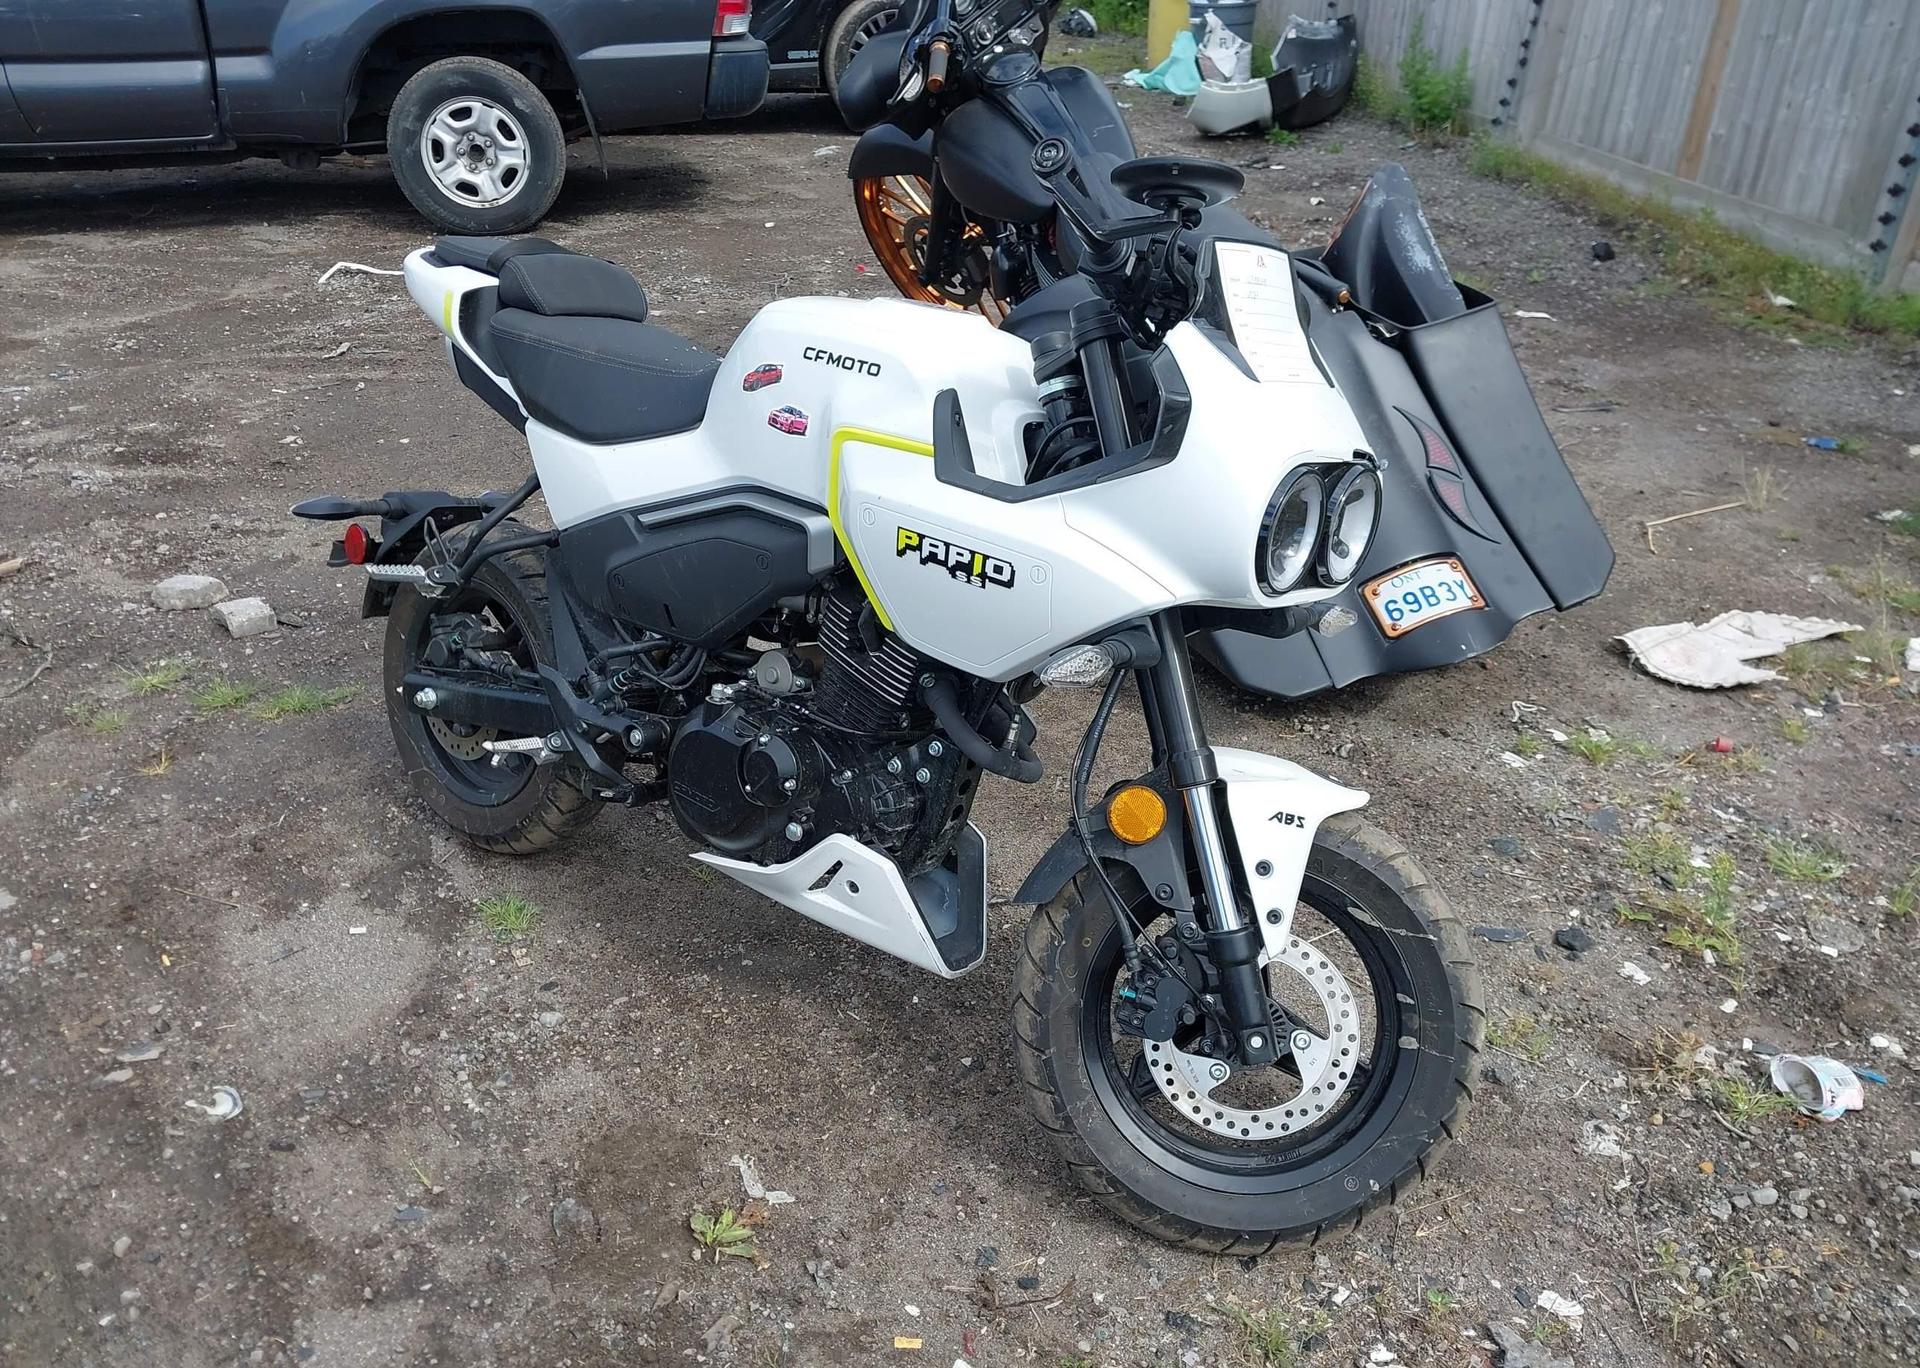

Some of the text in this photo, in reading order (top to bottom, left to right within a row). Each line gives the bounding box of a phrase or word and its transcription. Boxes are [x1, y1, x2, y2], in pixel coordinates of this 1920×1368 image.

[803, 346, 881, 377] CFMOTO
[897, 527, 1014, 585] PAPIO
[955, 571, 983, 587] SS
[1391, 571, 1421, 588] ONT
[1384, 579, 1474, 622] 69B3Y
[1268, 811, 1305, 829] ABS
